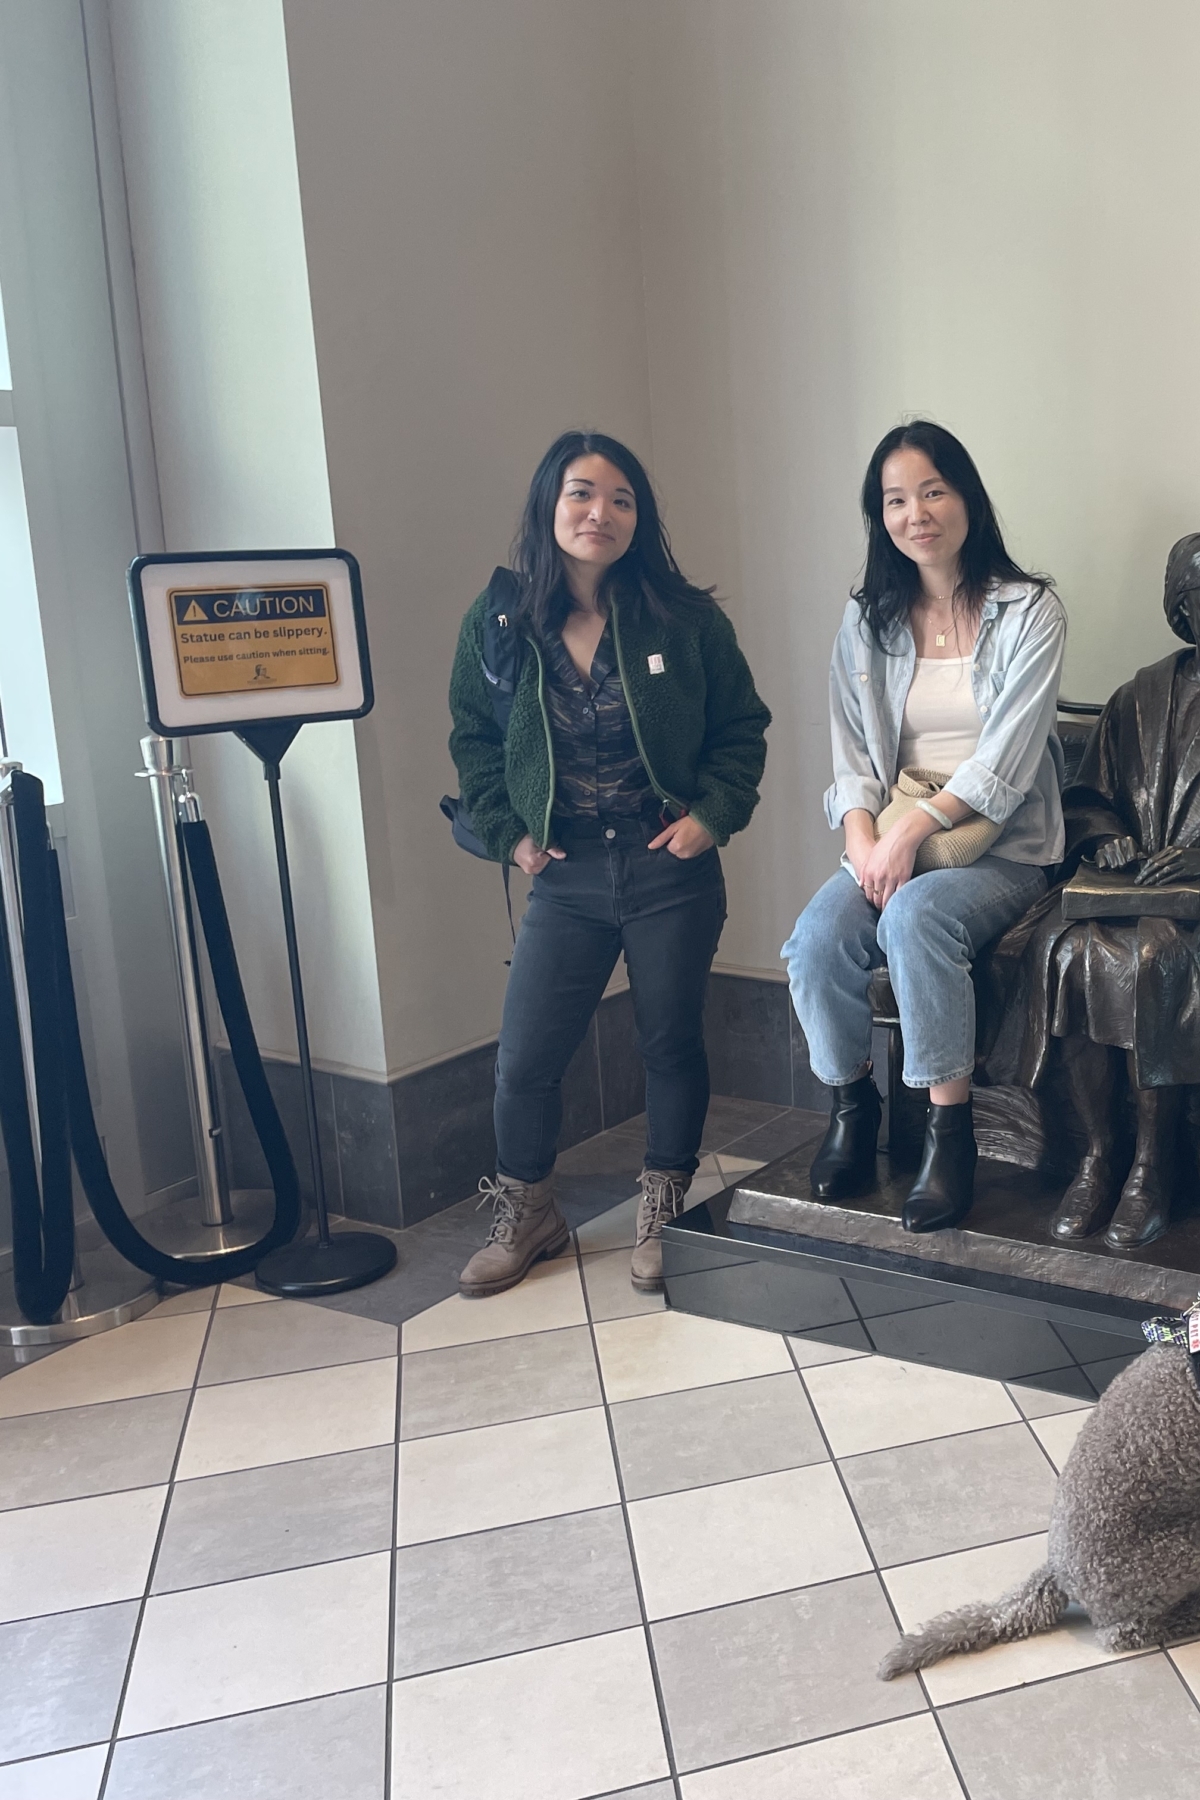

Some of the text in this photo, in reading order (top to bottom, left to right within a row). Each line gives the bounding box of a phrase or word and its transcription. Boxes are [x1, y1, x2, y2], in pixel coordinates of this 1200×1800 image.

[213, 595, 314, 618] CAUTION
[180, 626, 328, 644] Statue can be slippery.
[183, 646, 330, 664] Please use caution when sitting.
[1190, 1323, 1199, 1338] PET
